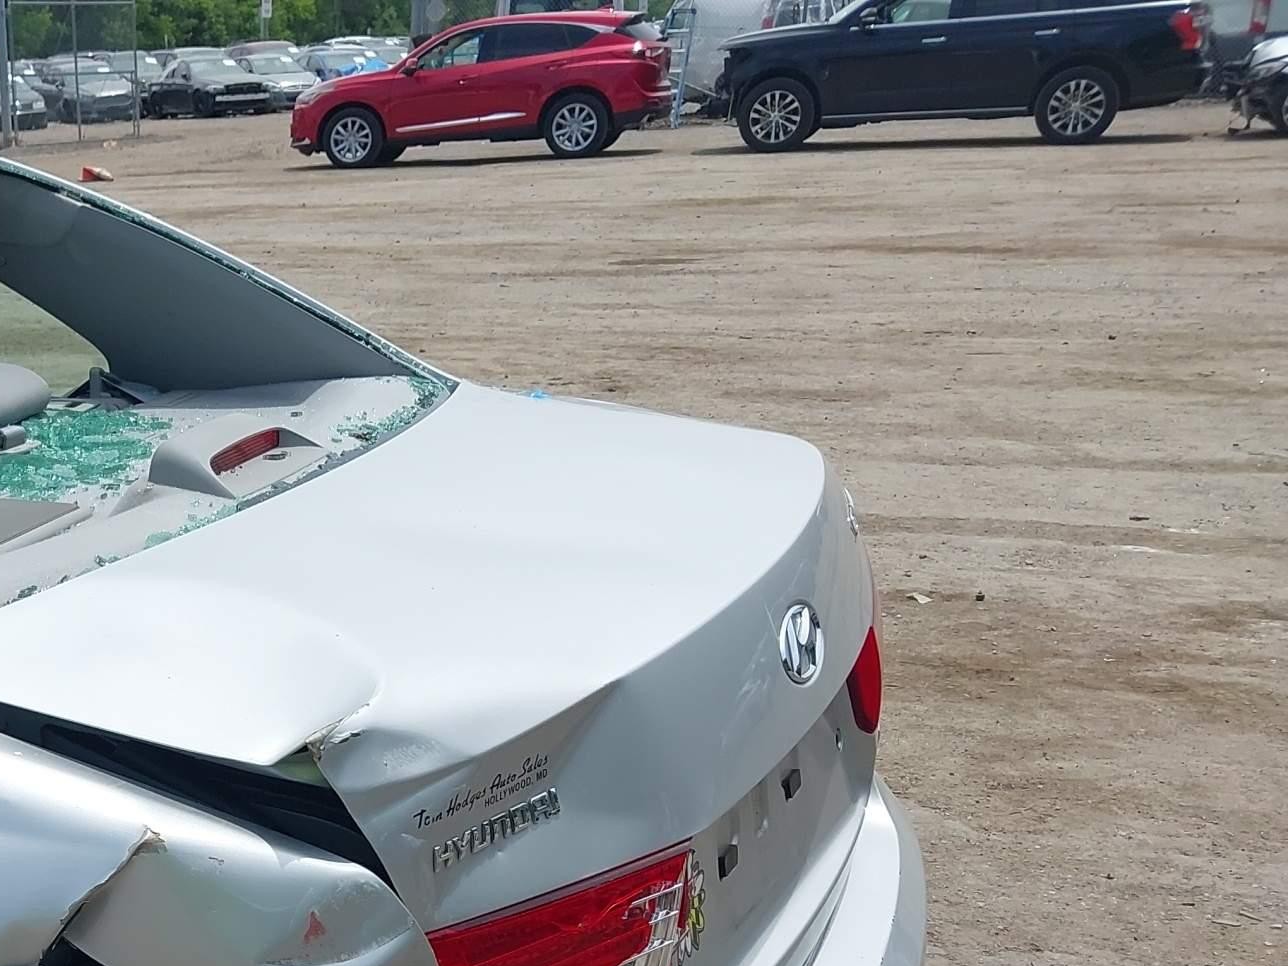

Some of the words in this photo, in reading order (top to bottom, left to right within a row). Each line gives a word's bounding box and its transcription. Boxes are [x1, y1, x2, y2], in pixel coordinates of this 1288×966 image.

[412, 808, 443, 829] Tom
[446, 788, 487, 817] Hodges
[489, 773, 516, 793] Auto
[518, 752, 548, 779] Sales
[536, 768, 548, 783] MD
[432, 787, 561, 873] HYUNDAI
